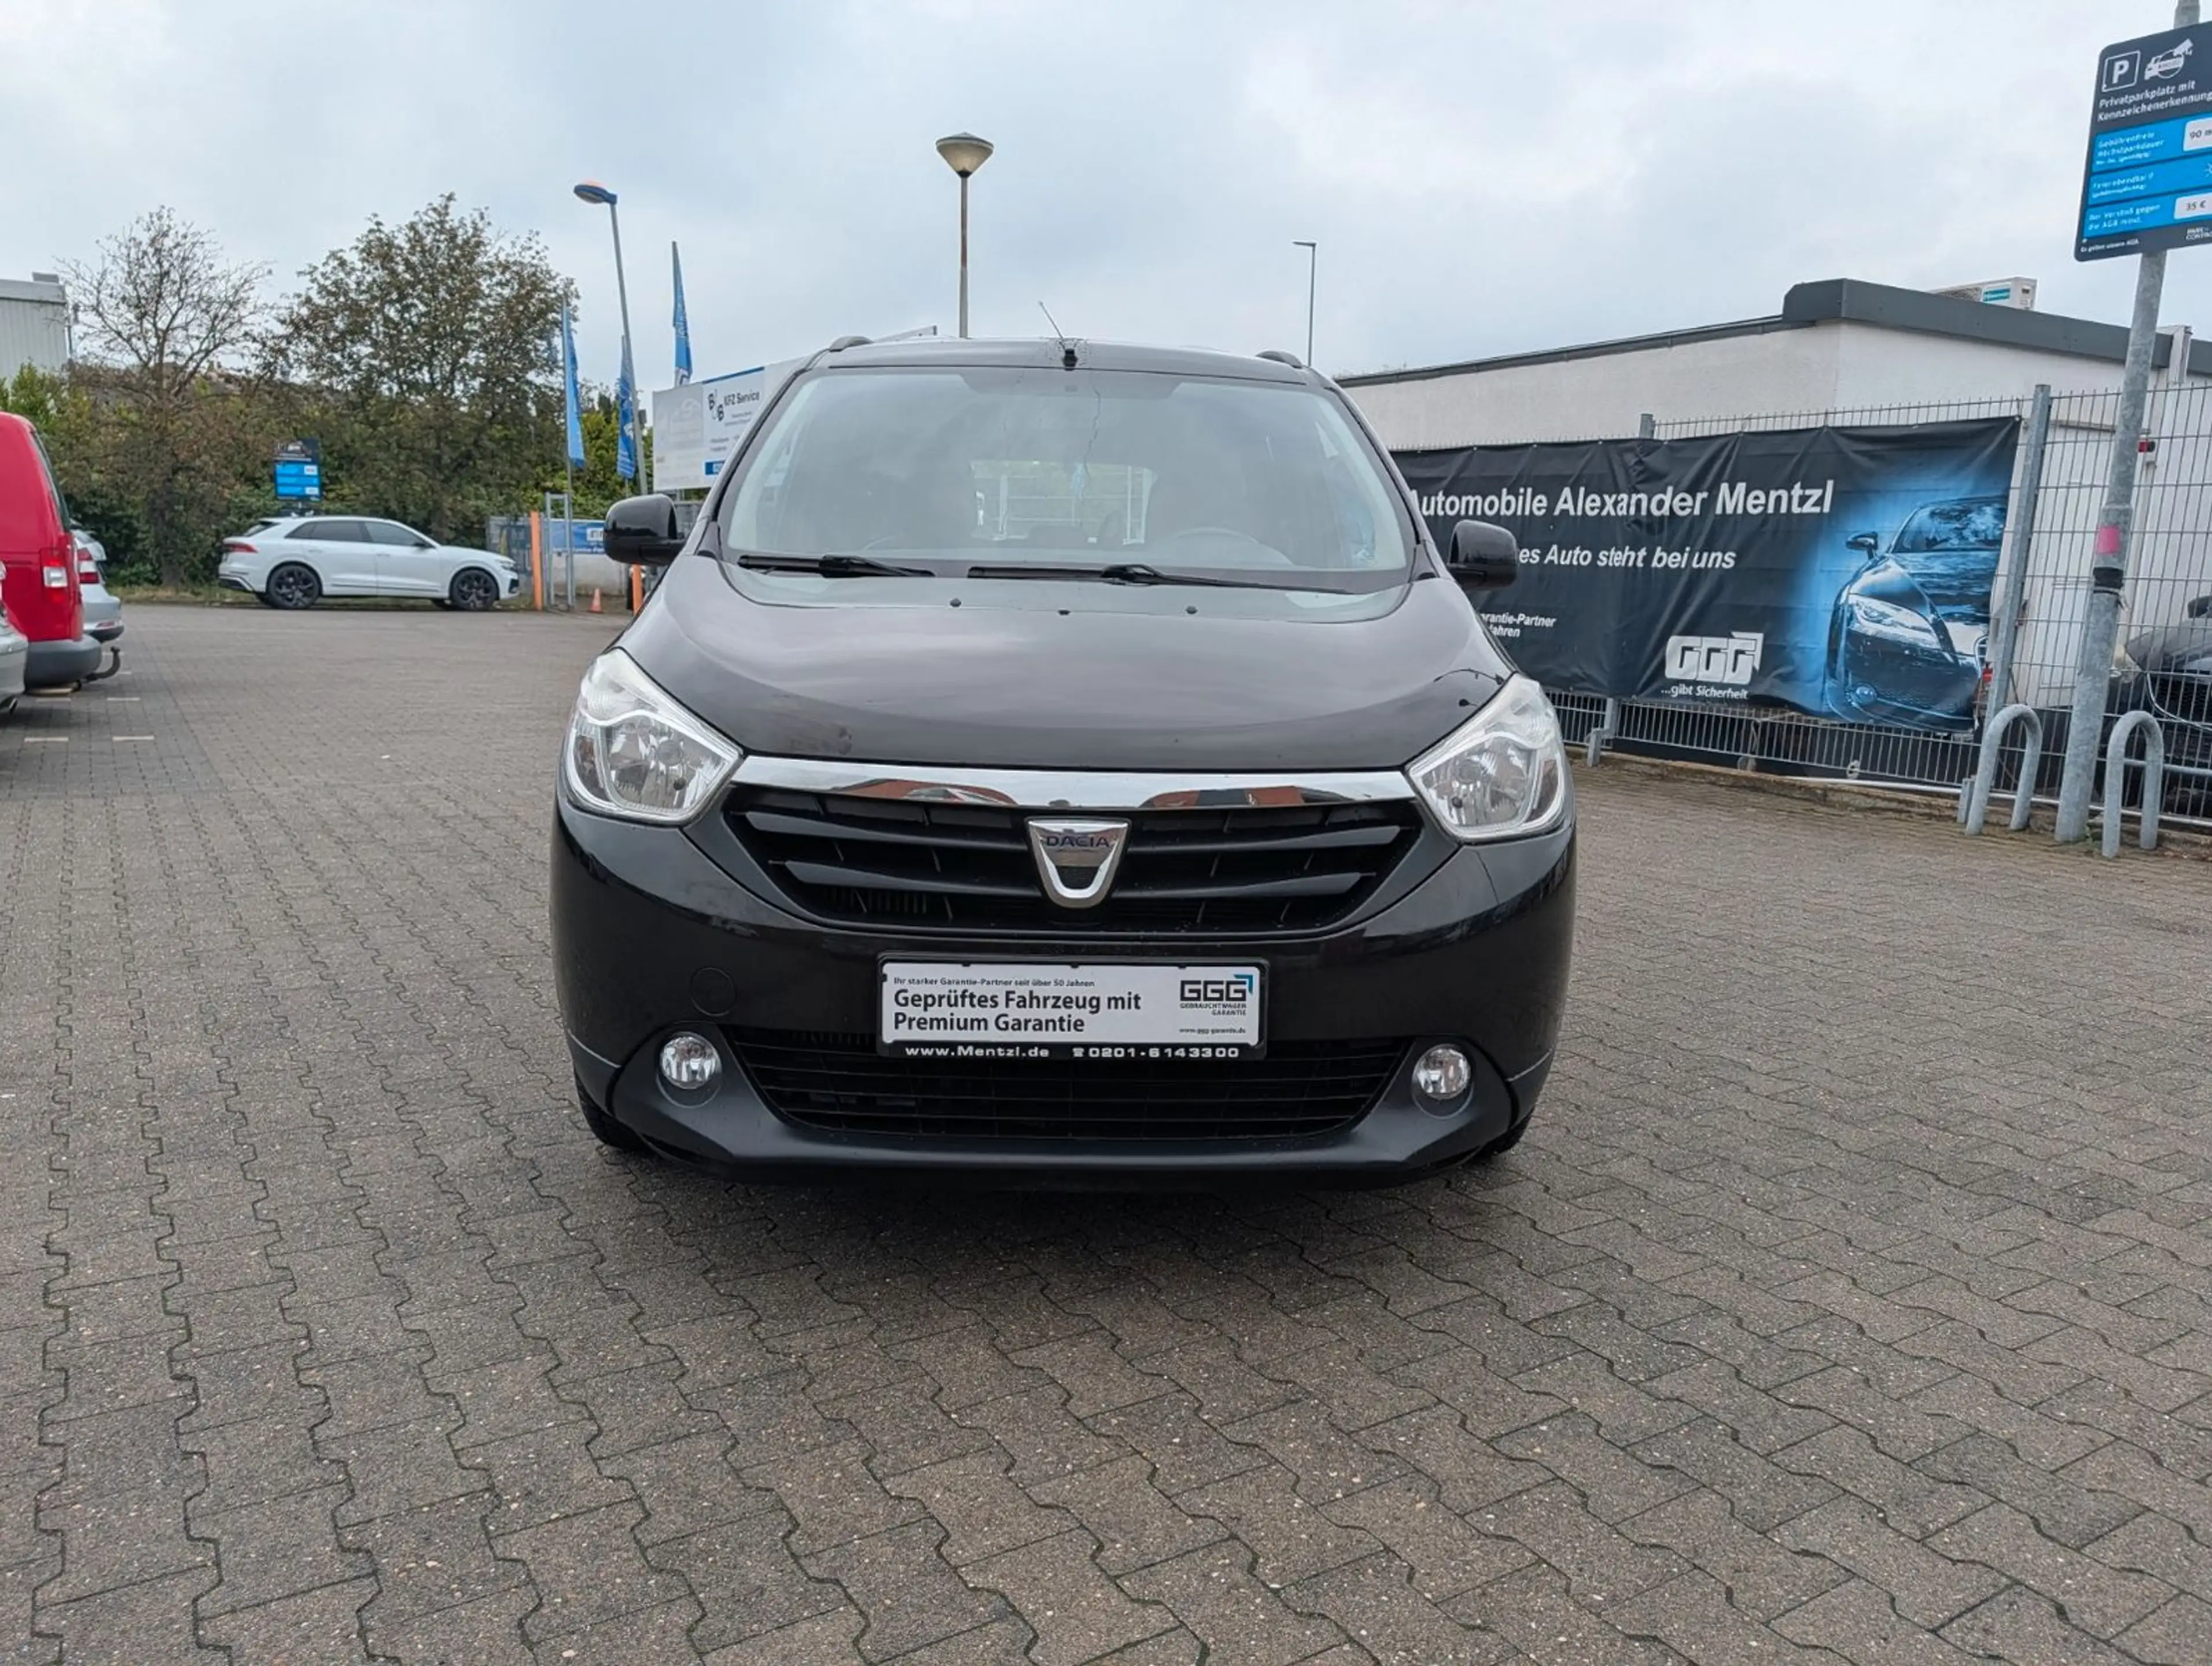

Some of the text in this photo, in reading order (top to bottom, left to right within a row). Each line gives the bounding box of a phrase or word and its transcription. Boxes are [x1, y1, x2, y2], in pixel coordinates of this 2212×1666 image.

[2099, 80, 2196, 108] Privatparkplatz mit
[2097, 91, 2212, 121] Kennzeichenerkennung
[737, 390, 760, 404] Service
[1554, 486, 1708, 517] Alexander
[1715, 480, 1834, 515] Mentzl
[1519, 544, 1736, 569] es Auto steht bei uns
[1696, 685, 1749, 699] Sicherheit
[1046, 835, 1110, 847] DACIA
[894, 976, 906, 985] Ihr
[908, 976, 938, 986] starker
[940, 978, 1013, 987] Garantie-Partner
[1014, 979, 1030, 987] seit
[1032, 979, 1051, 987] über
[1066, 979, 1095, 987] Jahren
[1180, 980, 1247, 1001] GGG
[894, 989, 1142, 1015] Geprüftes Fahrzeug mit
[894, 1012, 1085, 1033] Premium Garantie
[905, 1045, 1050, 1058] www.Mentzl.de
